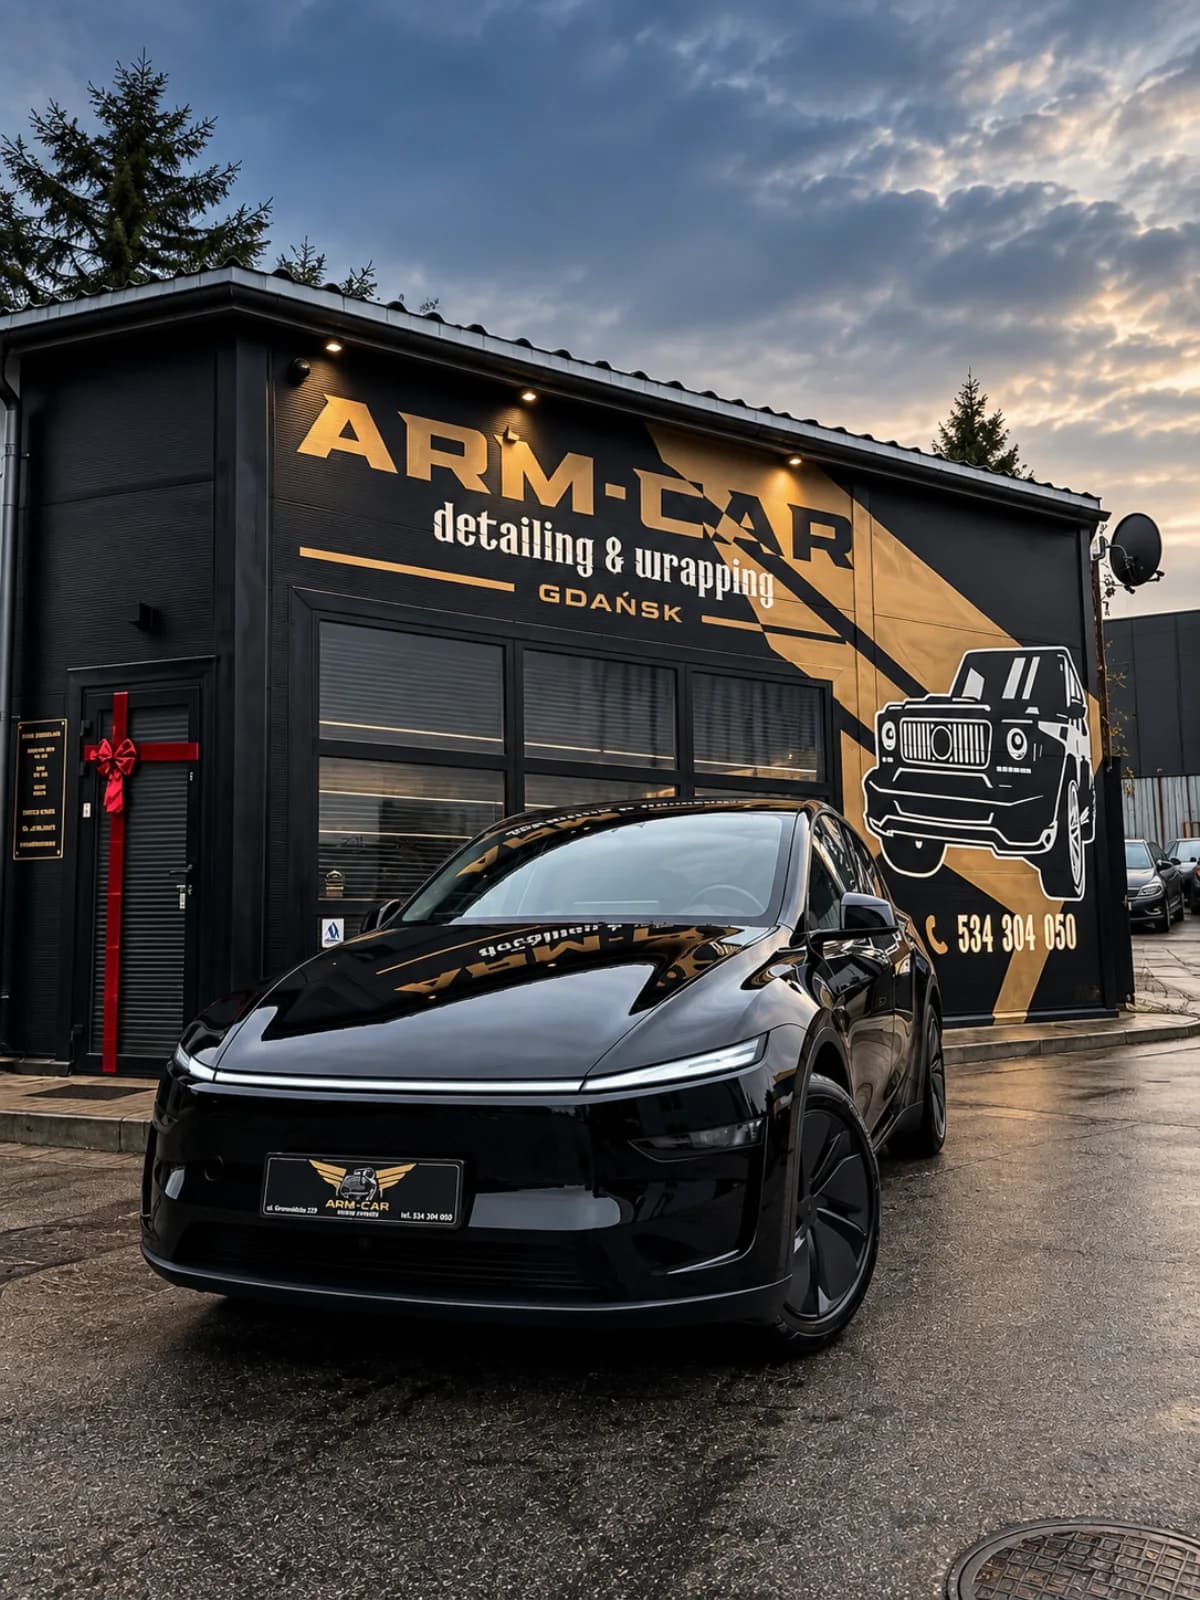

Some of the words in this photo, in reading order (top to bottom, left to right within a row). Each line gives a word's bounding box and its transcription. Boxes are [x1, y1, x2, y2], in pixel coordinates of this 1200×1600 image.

[297, 394, 854, 569] ARM-CAR
[434, 502, 593, 578] detailing
[605, 536, 624, 573] &
[635, 546, 775, 608] wrapping
[539, 584, 683, 623] GDAŃSK
[957, 914, 994, 952] 534
[1002, 913, 1036, 951] 304
[1044, 912, 1077, 950] 050
[325, 1199, 390, 1211] ARM-CAR
